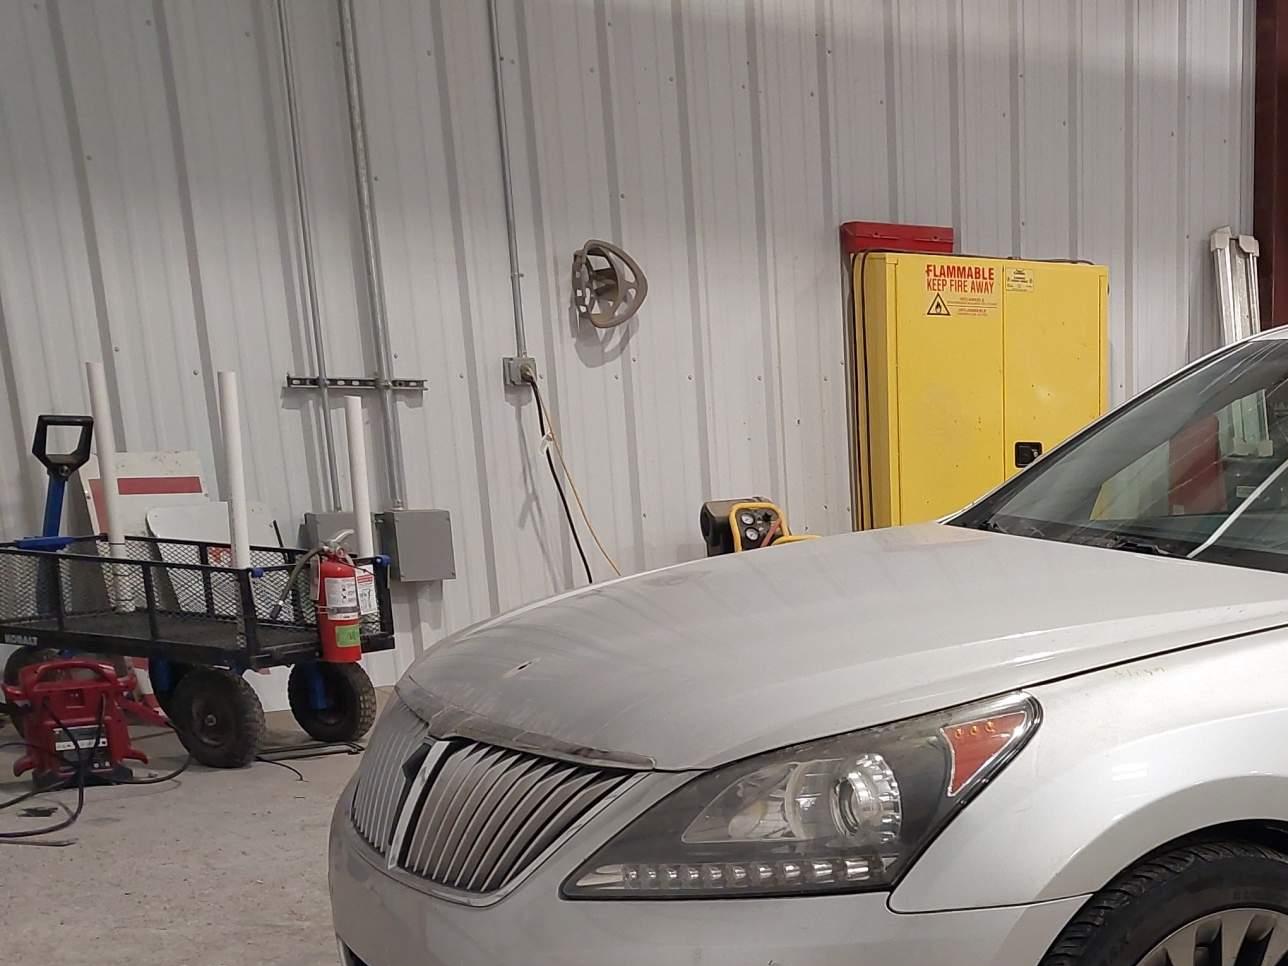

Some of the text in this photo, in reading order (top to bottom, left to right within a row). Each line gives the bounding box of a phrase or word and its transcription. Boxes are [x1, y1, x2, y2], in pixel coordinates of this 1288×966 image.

[926, 264, 995, 281] FLAMMABLE
[927, 278, 947, 292] KEEP
[950, 279, 968, 293] FIRE
[970, 280, 995, 294] AWAY
